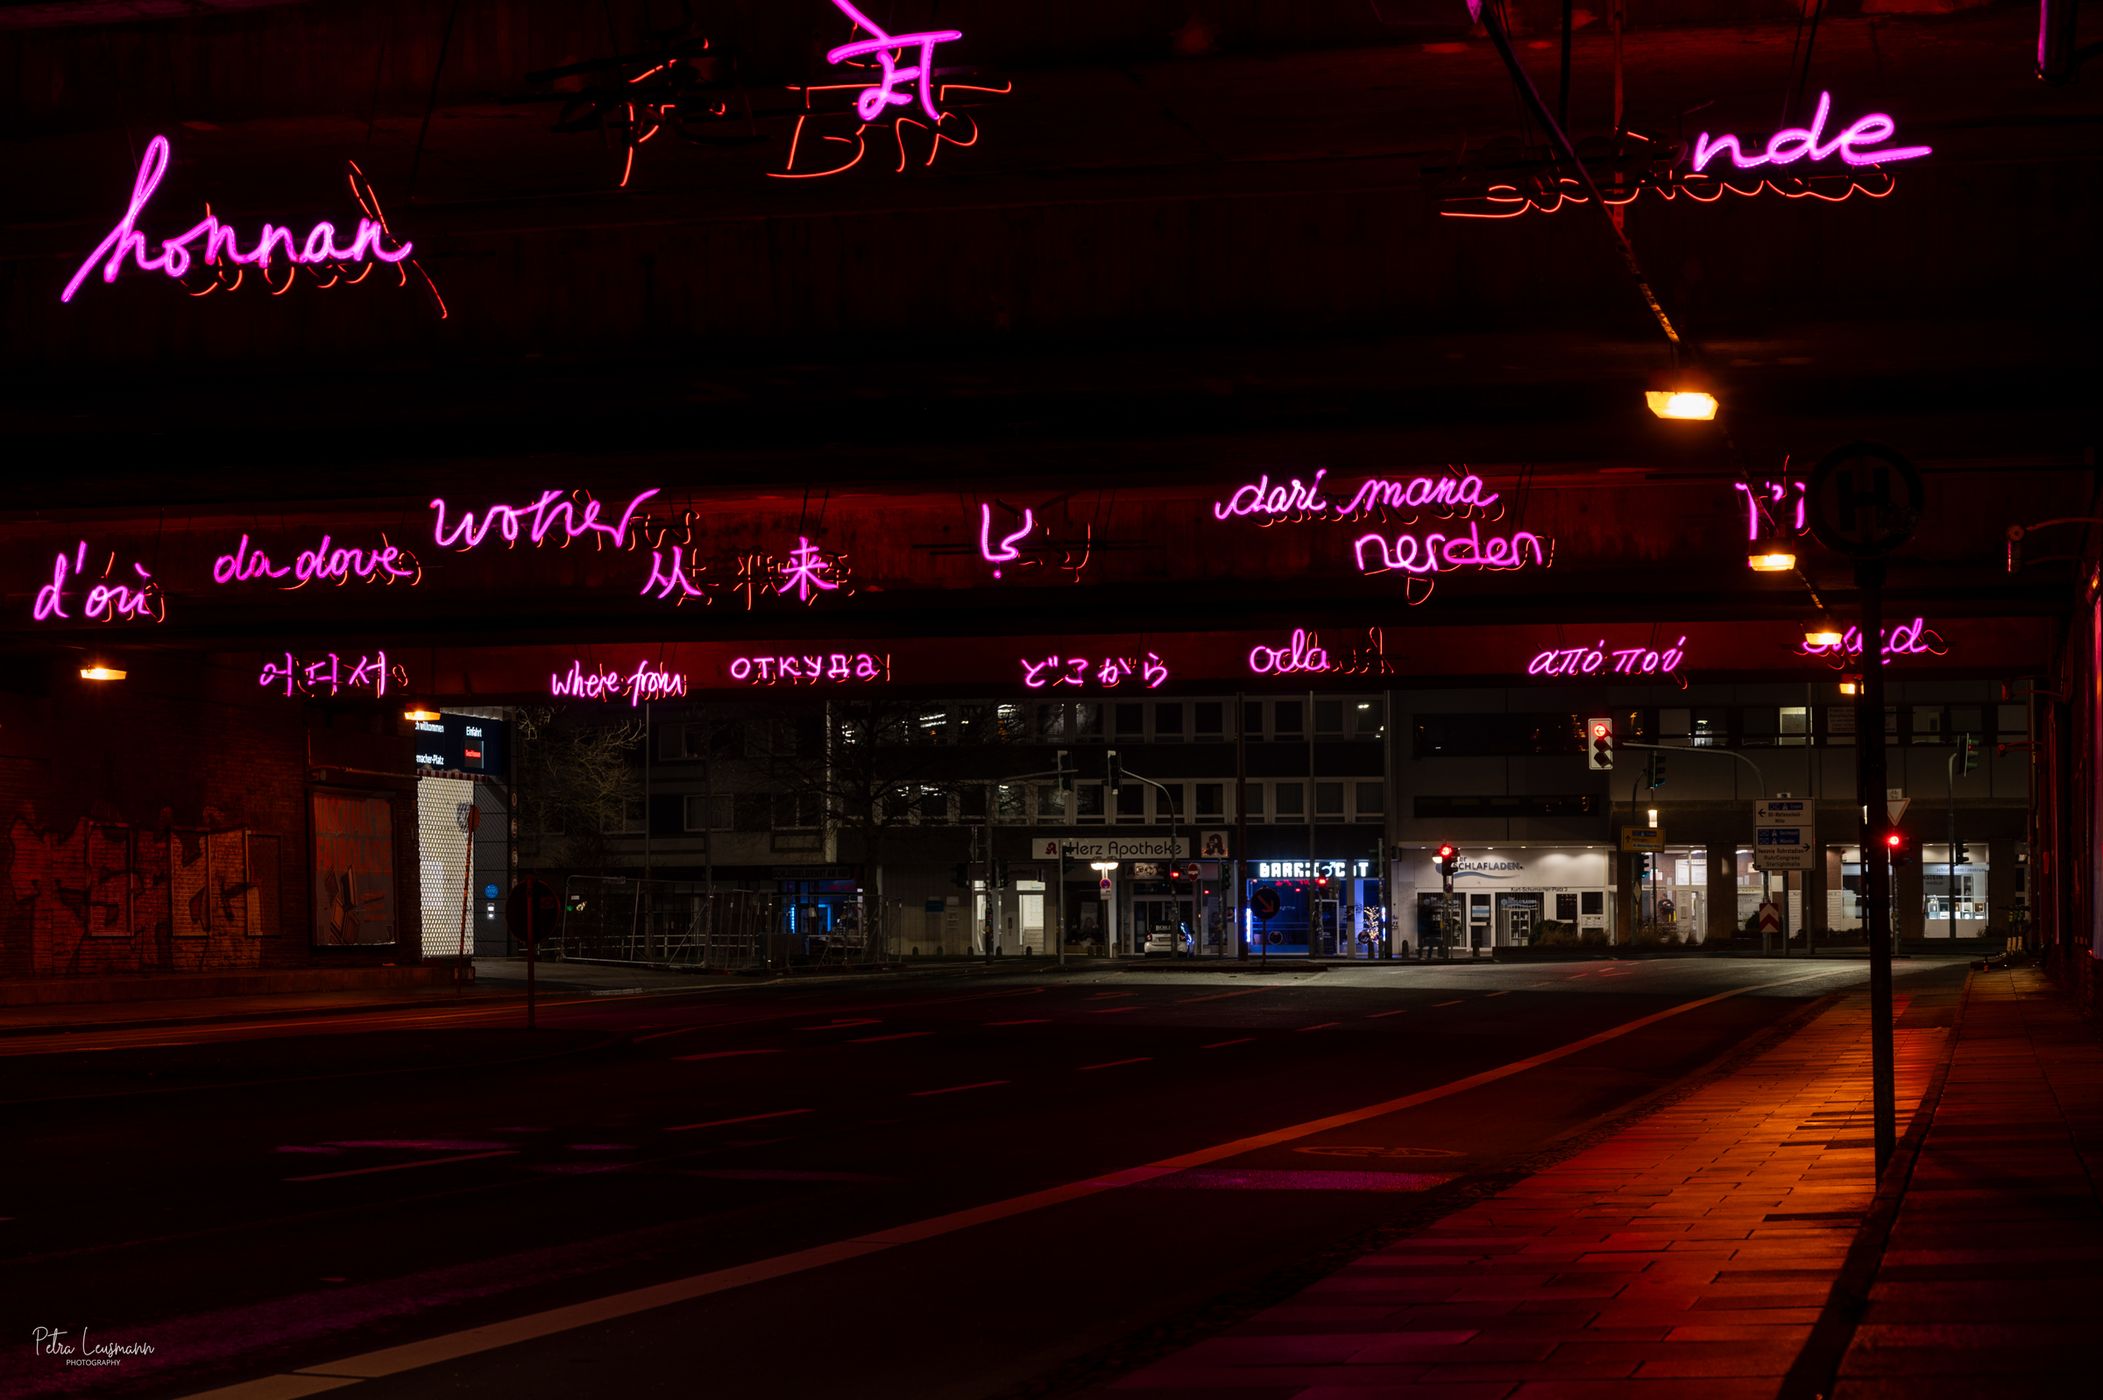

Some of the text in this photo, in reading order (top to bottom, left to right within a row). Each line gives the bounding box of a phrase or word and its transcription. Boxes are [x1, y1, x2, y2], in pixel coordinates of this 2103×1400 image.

[61, 134, 413, 303] honnan
[1214, 468, 1499, 521] dari mana
[213, 534, 413, 584] da dove
[1354, 521, 1543, 573] nerden
[551, 659, 620, 698] where
[730, 653, 878, 679] откуда
[1527, 639, 1606, 675] από
[1068, 841, 1103, 855] Herz
[1108, 841, 1183, 858] Apotheke
